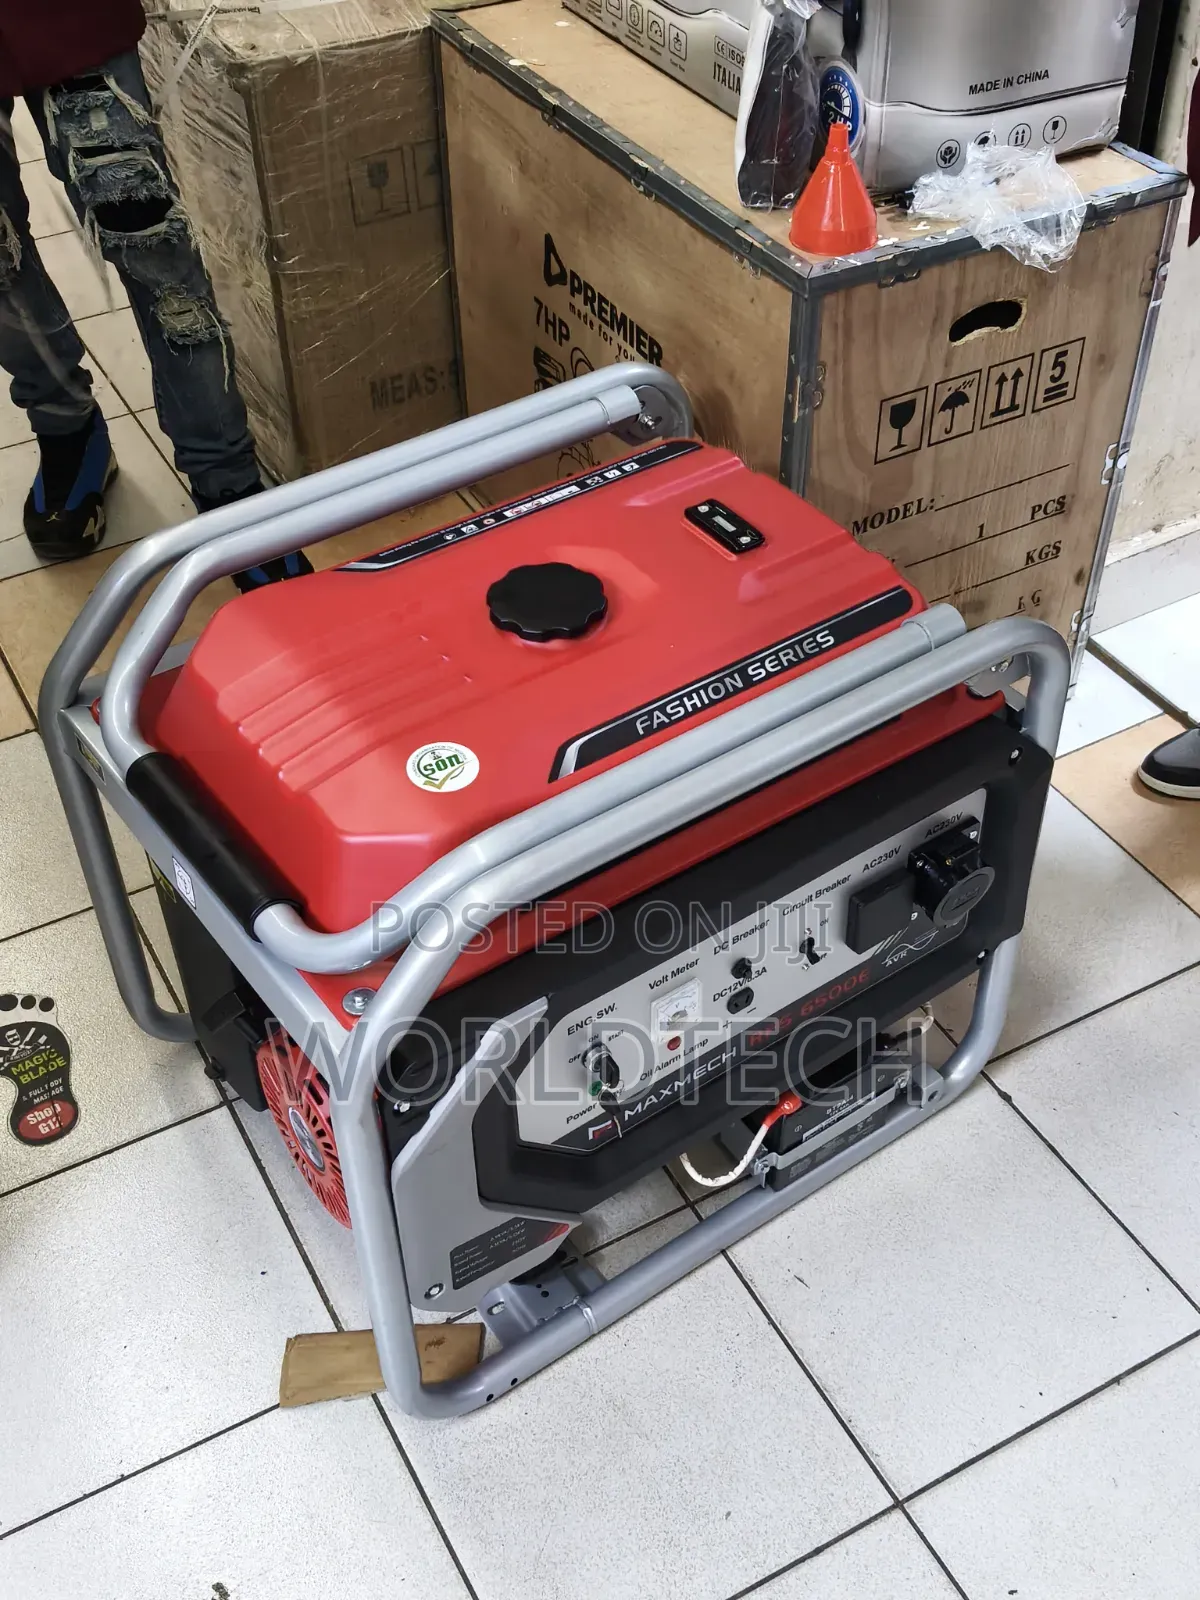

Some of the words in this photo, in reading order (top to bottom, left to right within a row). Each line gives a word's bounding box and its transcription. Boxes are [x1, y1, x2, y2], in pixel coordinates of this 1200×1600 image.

[969, 79, 1001, 95] MADE
[1003, 76, 1014, 88] IN
[1016, 69, 1049, 85] CHINA
[534, 296, 571, 347] 7HP
[569, 269, 663, 368] PREMIER
[569, 302, 595, 331] made
[598, 324, 613, 346] for
[1049, 350, 1069, 384] 5
[852, 498, 935, 537] MODEL:
[976, 523, 986, 540] 1
[1030, 495, 1067, 521] PCS
[1024, 540, 1062, 567] KGS
[636, 672, 744, 735] FASHION
[747, 630, 835, 682] SERIES
[925, 811, 964, 839] AC230V
[862, 845, 902, 873] AC230V
[782, 892, 813, 917] Circuit
[815, 874, 852, 900] Breaker
[713, 941, 729, 956] DC
[732, 919, 770, 946] Breaker
[648, 974, 669, 990] Volt
[671, 958, 700, 979] Meter
[885, 950, 908, 967] AVR
[567, 1003, 618, 1036] ENG.SW.
[589, 1034, 600, 1042] ON
[11, 1048, 58, 1075] MAGIC
[20, 1056, 67, 1085] BLADE
[568, 1053, 581, 1063] OFF
[654, 1054, 681, 1073] Alarm
[683, 1038, 709, 1056] Lamp
[28, 1087, 45, 1099] FULL
[624, 1046, 737, 1121] MAXMECH
[26, 1103, 61, 1125] Shop
[566, 1102, 598, 1125] Power
